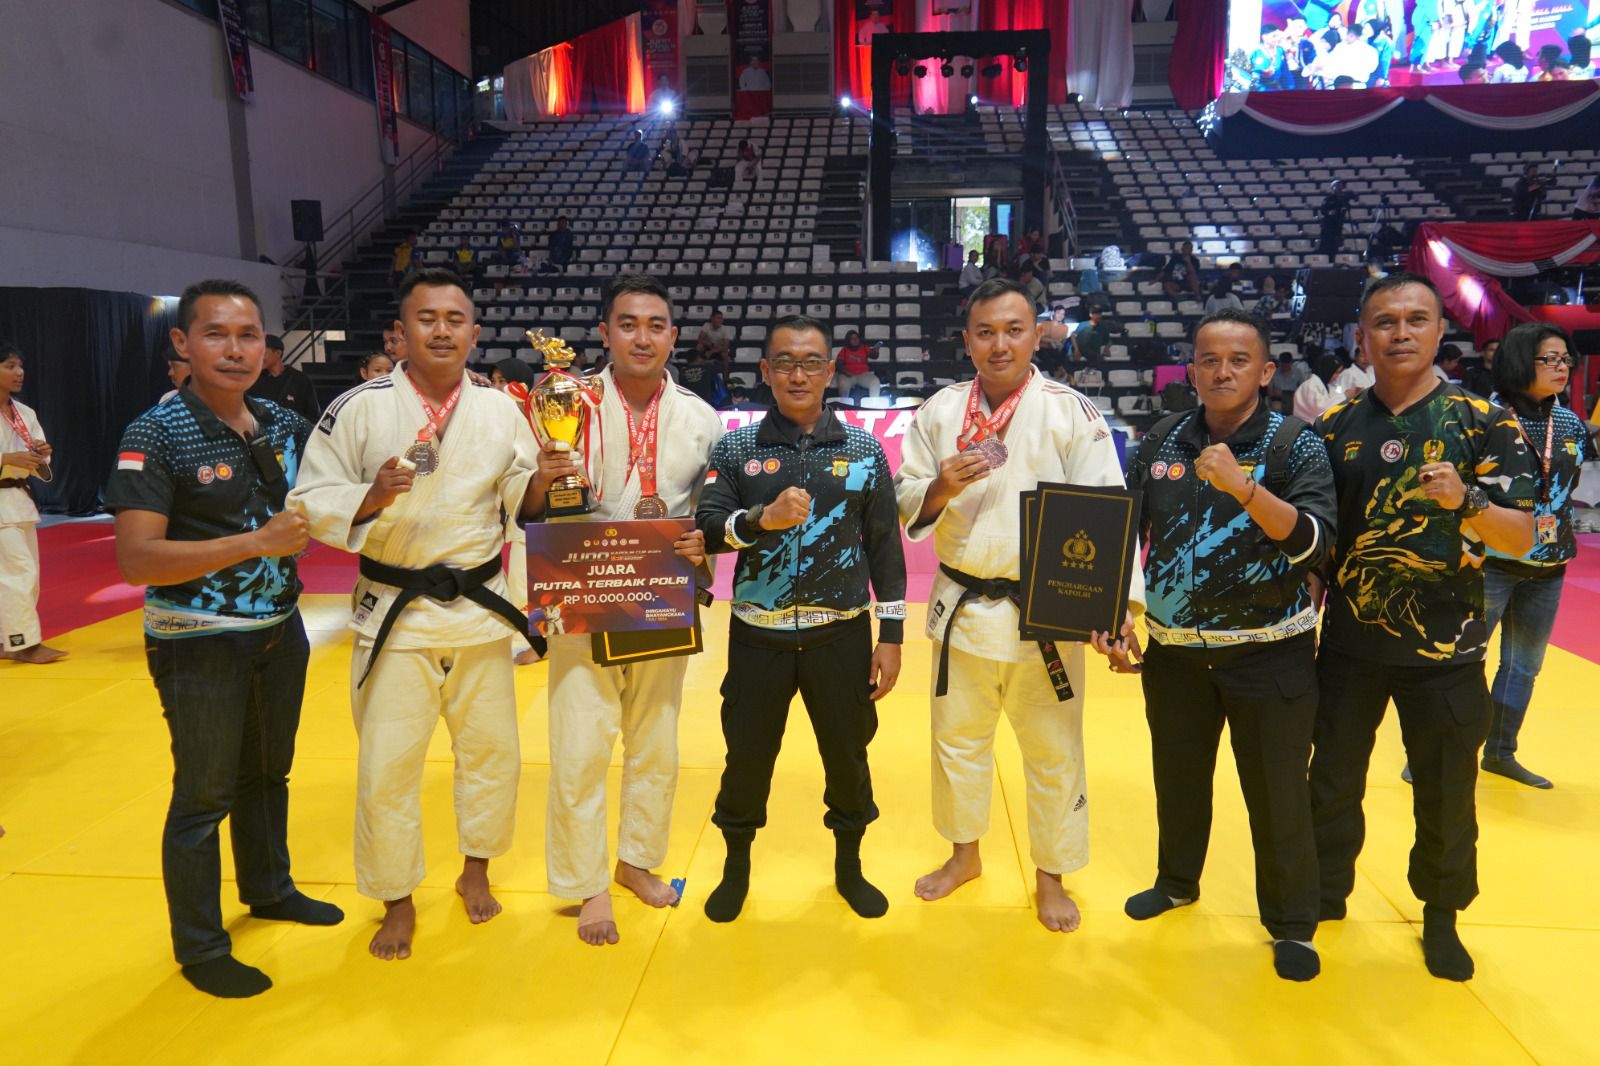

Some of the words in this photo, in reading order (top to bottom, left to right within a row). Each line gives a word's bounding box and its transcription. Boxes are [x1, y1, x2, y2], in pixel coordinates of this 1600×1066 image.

[587, 564, 636, 576] JUARA
[533, 580, 582, 591] PUTRA
[587, 577, 645, 589] TERBAIK
[649, 576, 689, 586] POLRI
[1048, 580, 1103, 592] PENGHARGAAN
[563, 595, 580, 605] RP
[583, 591, 660, 605] 10.000.000,-
[1057, 588, 1091, 599] KAPOLRI
